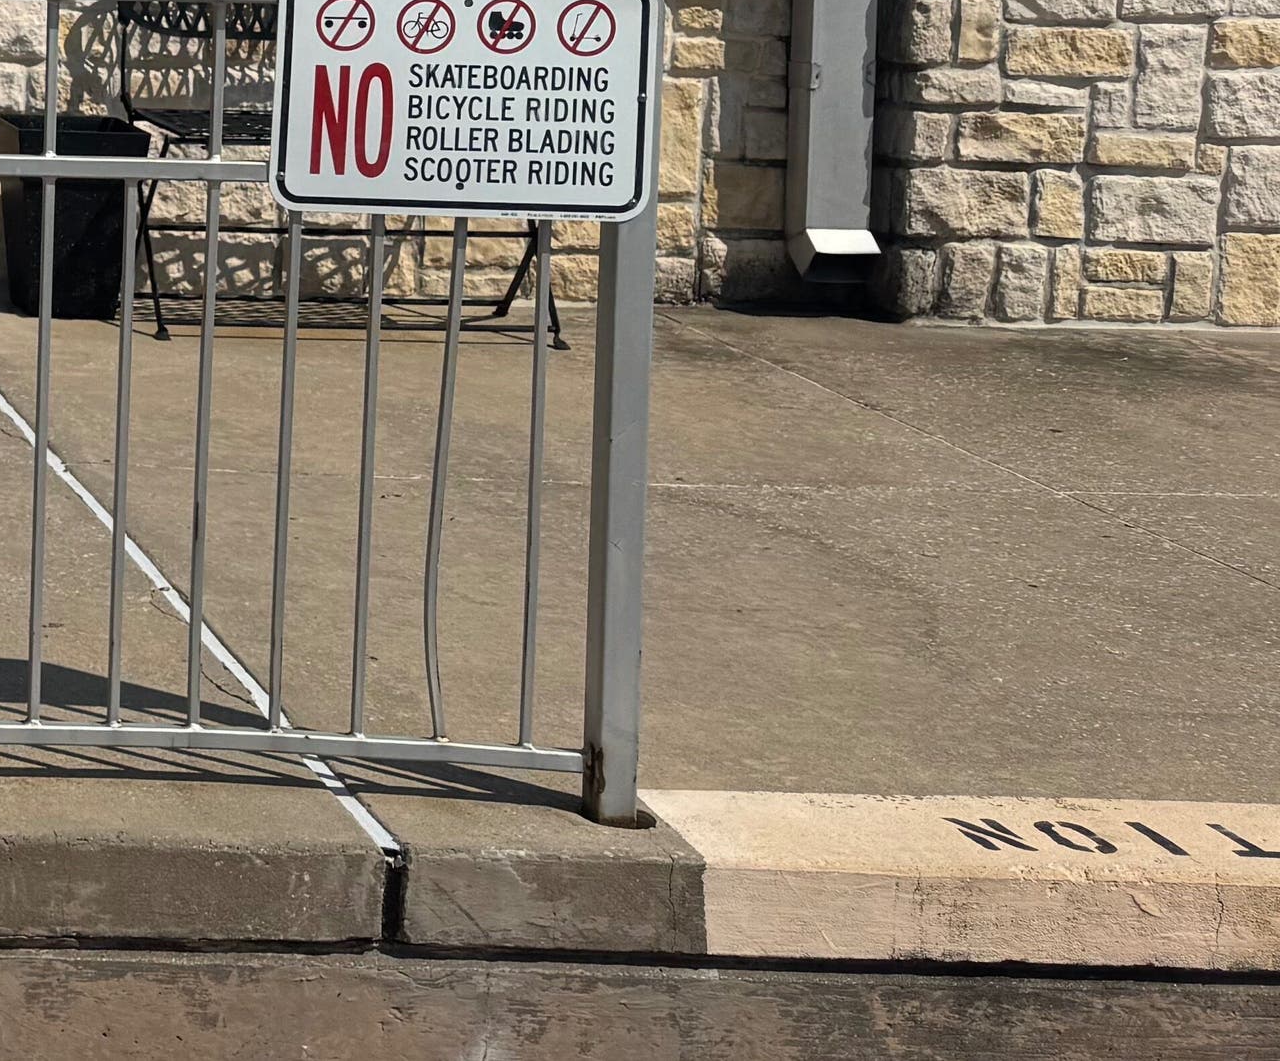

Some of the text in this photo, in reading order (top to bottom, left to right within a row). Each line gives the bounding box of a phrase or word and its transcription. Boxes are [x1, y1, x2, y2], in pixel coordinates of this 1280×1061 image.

[408, 63, 610, 92] SKATEBOARDING
[309, 62, 394, 179] NO
[407, 95, 616, 124] BICYCLE RIDING
[405, 126, 616, 156] ROLLER BLADING
[403, 157, 614, 187] SCOOTER RIDING
